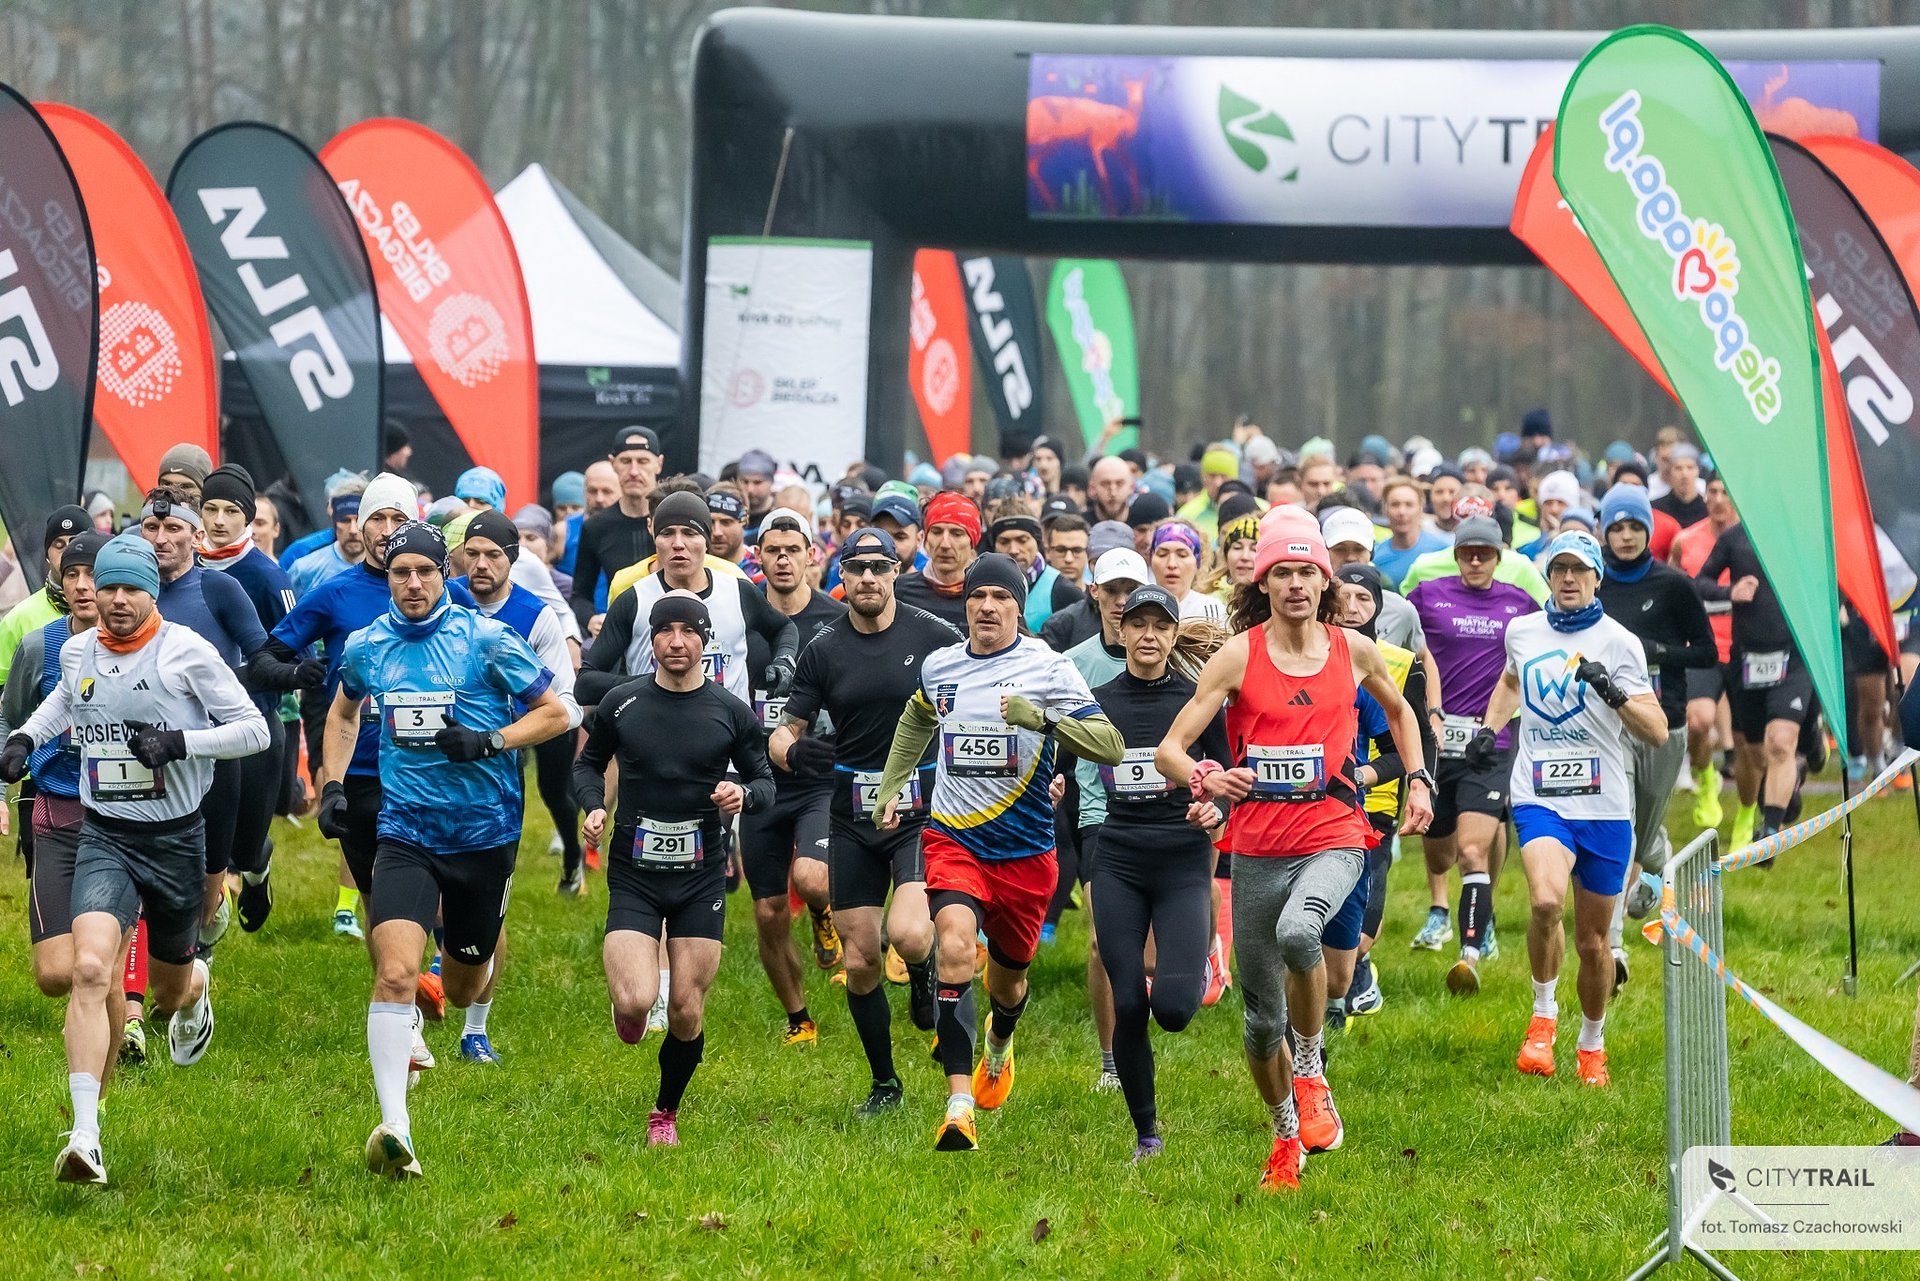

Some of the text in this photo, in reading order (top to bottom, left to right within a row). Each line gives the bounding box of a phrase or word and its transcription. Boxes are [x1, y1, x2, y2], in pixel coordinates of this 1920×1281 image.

[1452, 617, 1503, 630] TRIATHLON
[1459, 625, 1495, 636] POLSKA
[411, 709, 425, 728] 3
[959, 738, 1001, 756] 456
[118, 762, 128, 780] 1
[1131, 764, 1145, 782] 9
[1263, 762, 1306, 781] 1116
[1548, 762, 1584, 779] 222
[652, 836, 685, 852] 291
